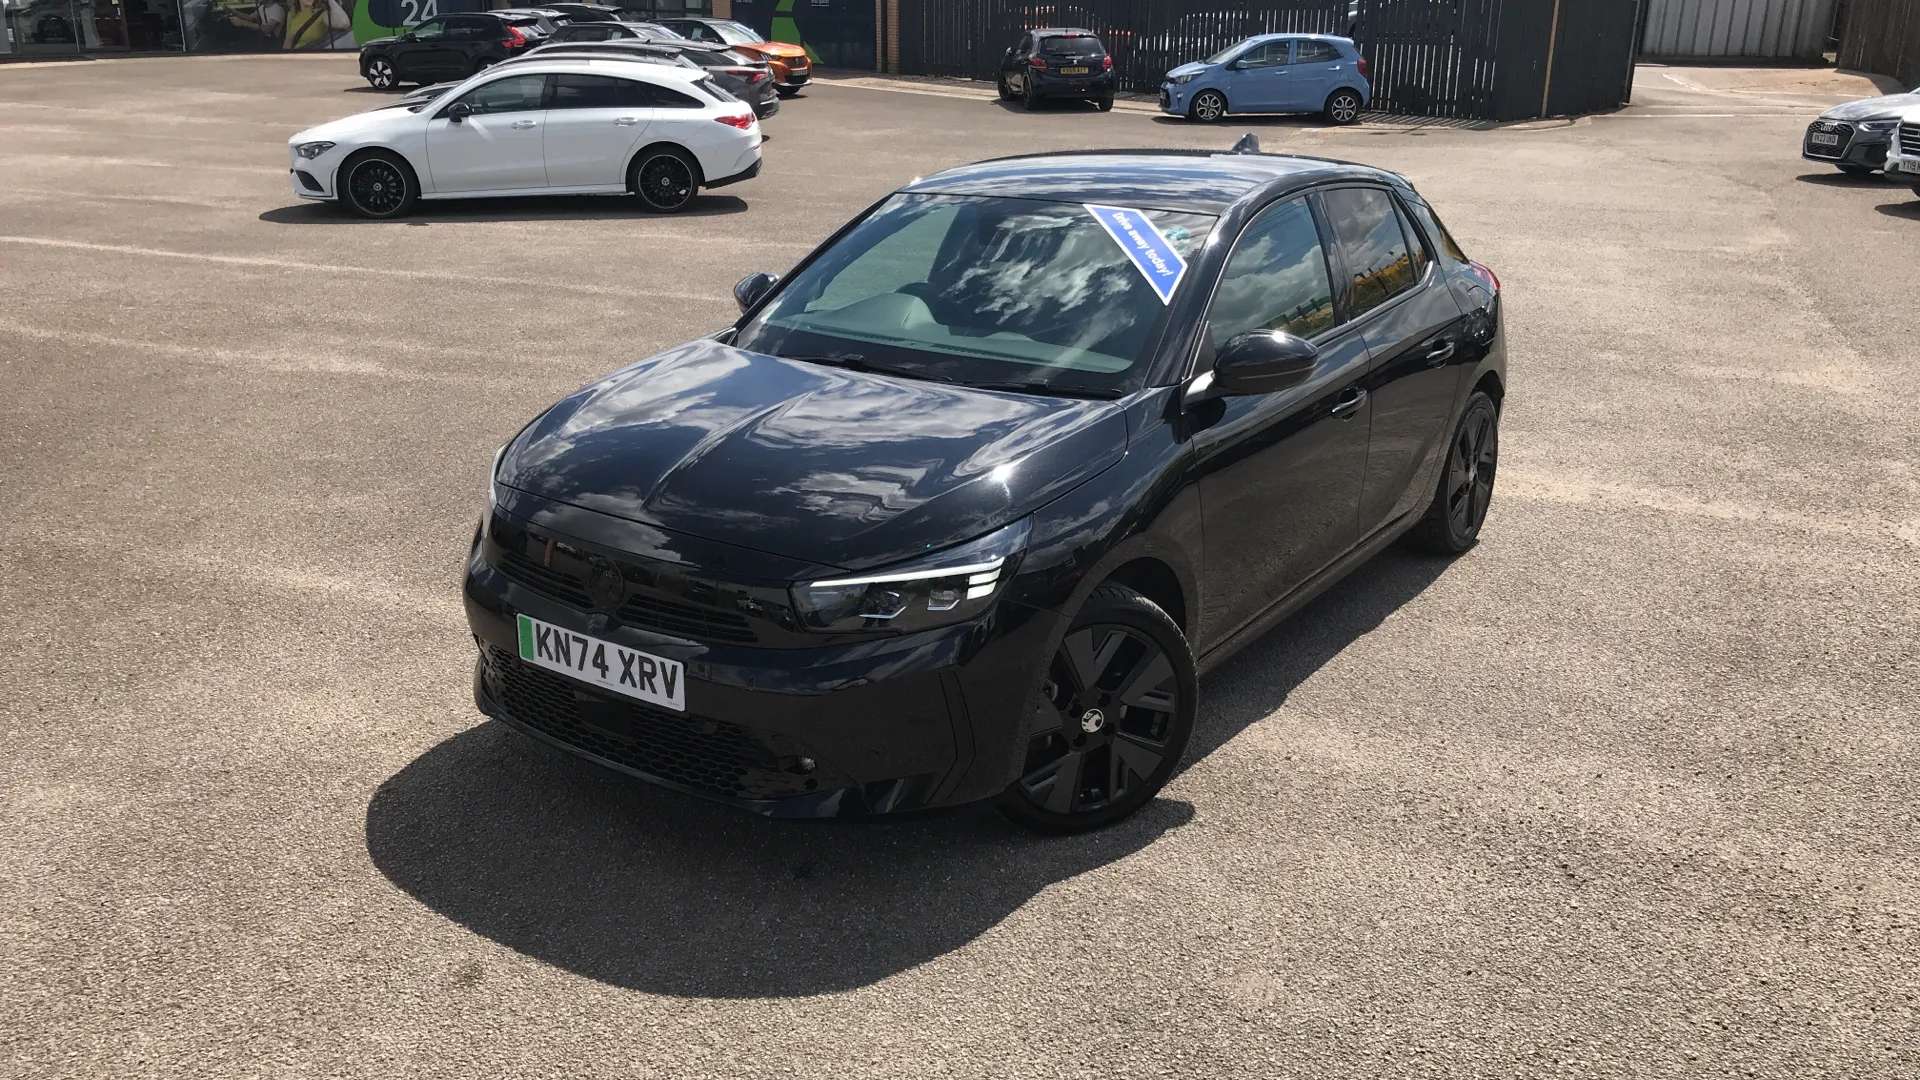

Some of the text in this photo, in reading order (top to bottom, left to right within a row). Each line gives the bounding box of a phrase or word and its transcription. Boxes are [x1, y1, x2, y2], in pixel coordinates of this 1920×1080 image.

[400, 0, 438, 26] 24
[1128, 228, 1150, 250] away
[1145, 247, 1174, 277] today!
[535, 623, 678, 700] KN74 XRV
